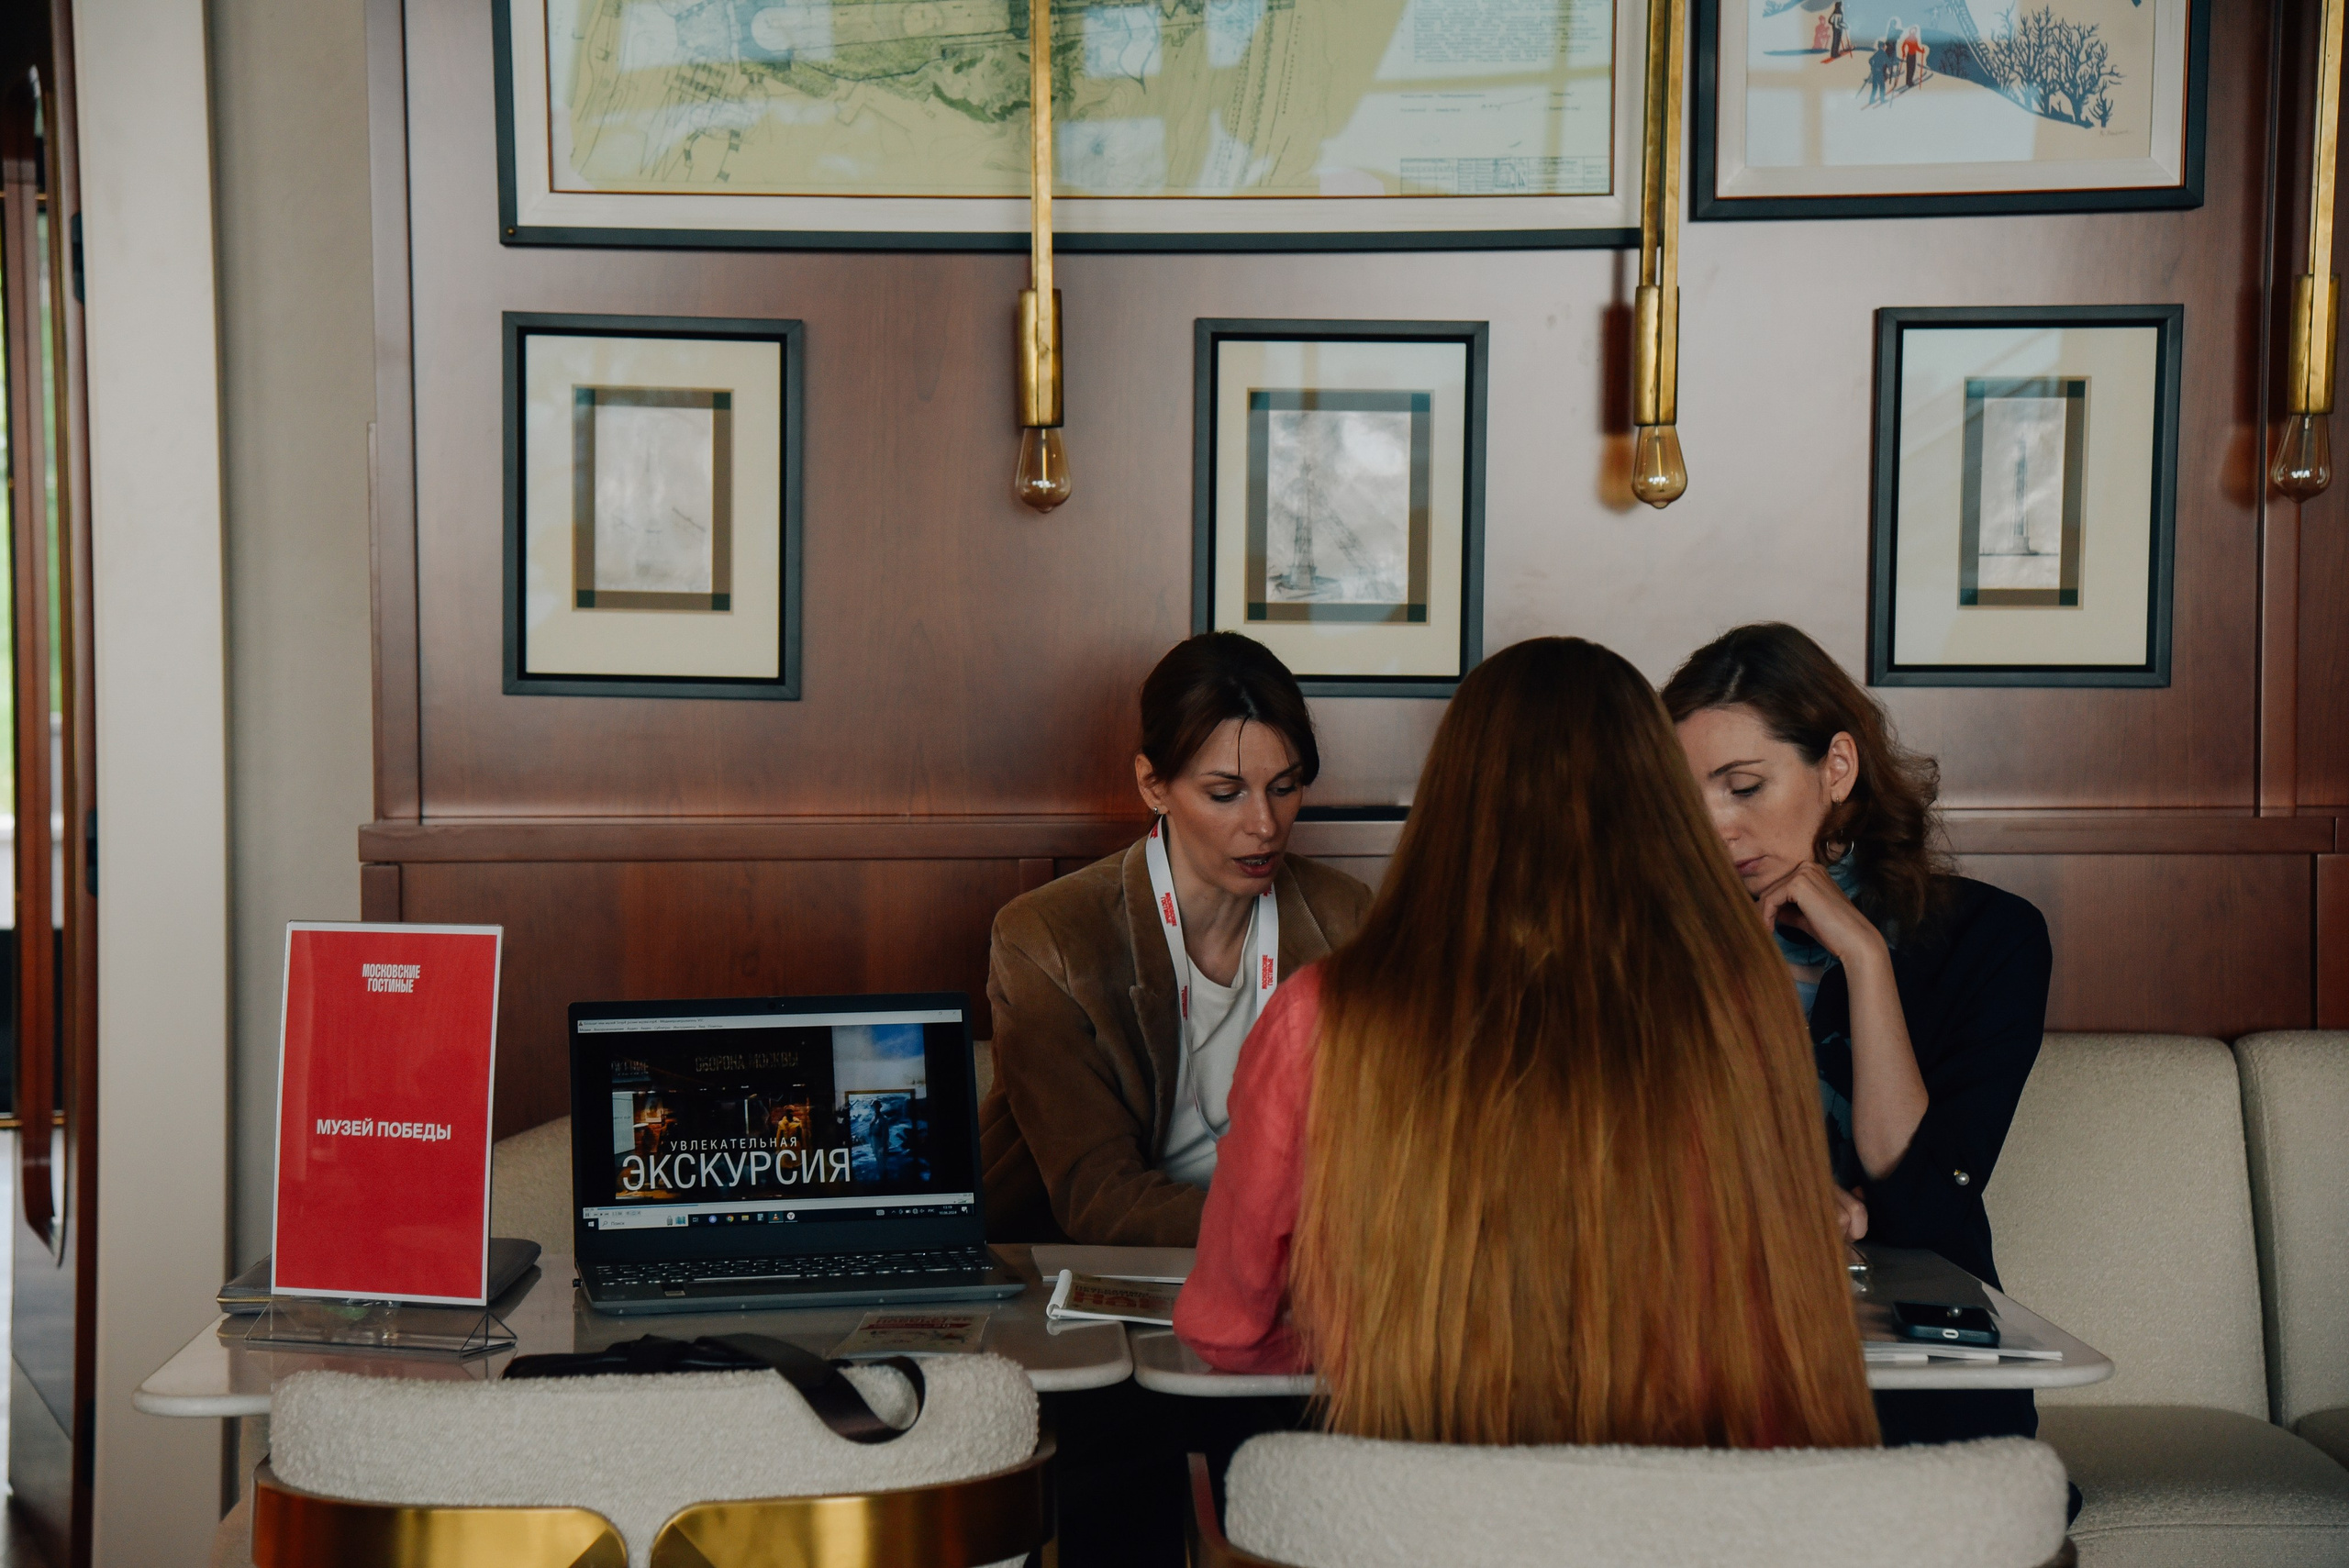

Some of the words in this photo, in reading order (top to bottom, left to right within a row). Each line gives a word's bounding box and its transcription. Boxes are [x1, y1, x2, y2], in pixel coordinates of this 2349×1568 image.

[362, 963, 420, 979] МОСКОВСКИЕ
[367, 978, 414, 993] ГОСТИНЫЕ
[696, 1054, 745, 1072] ОБОРОНА
[317, 1118, 373, 1137] МУЗЕЙ
[377, 1121, 451, 1141] ПОБЕДЫ
[671, 1136, 796, 1151] УВЛЕКАТЕЛЬНАЯ
[622, 1148, 851, 1191] ЭКСКУРСИЯ
